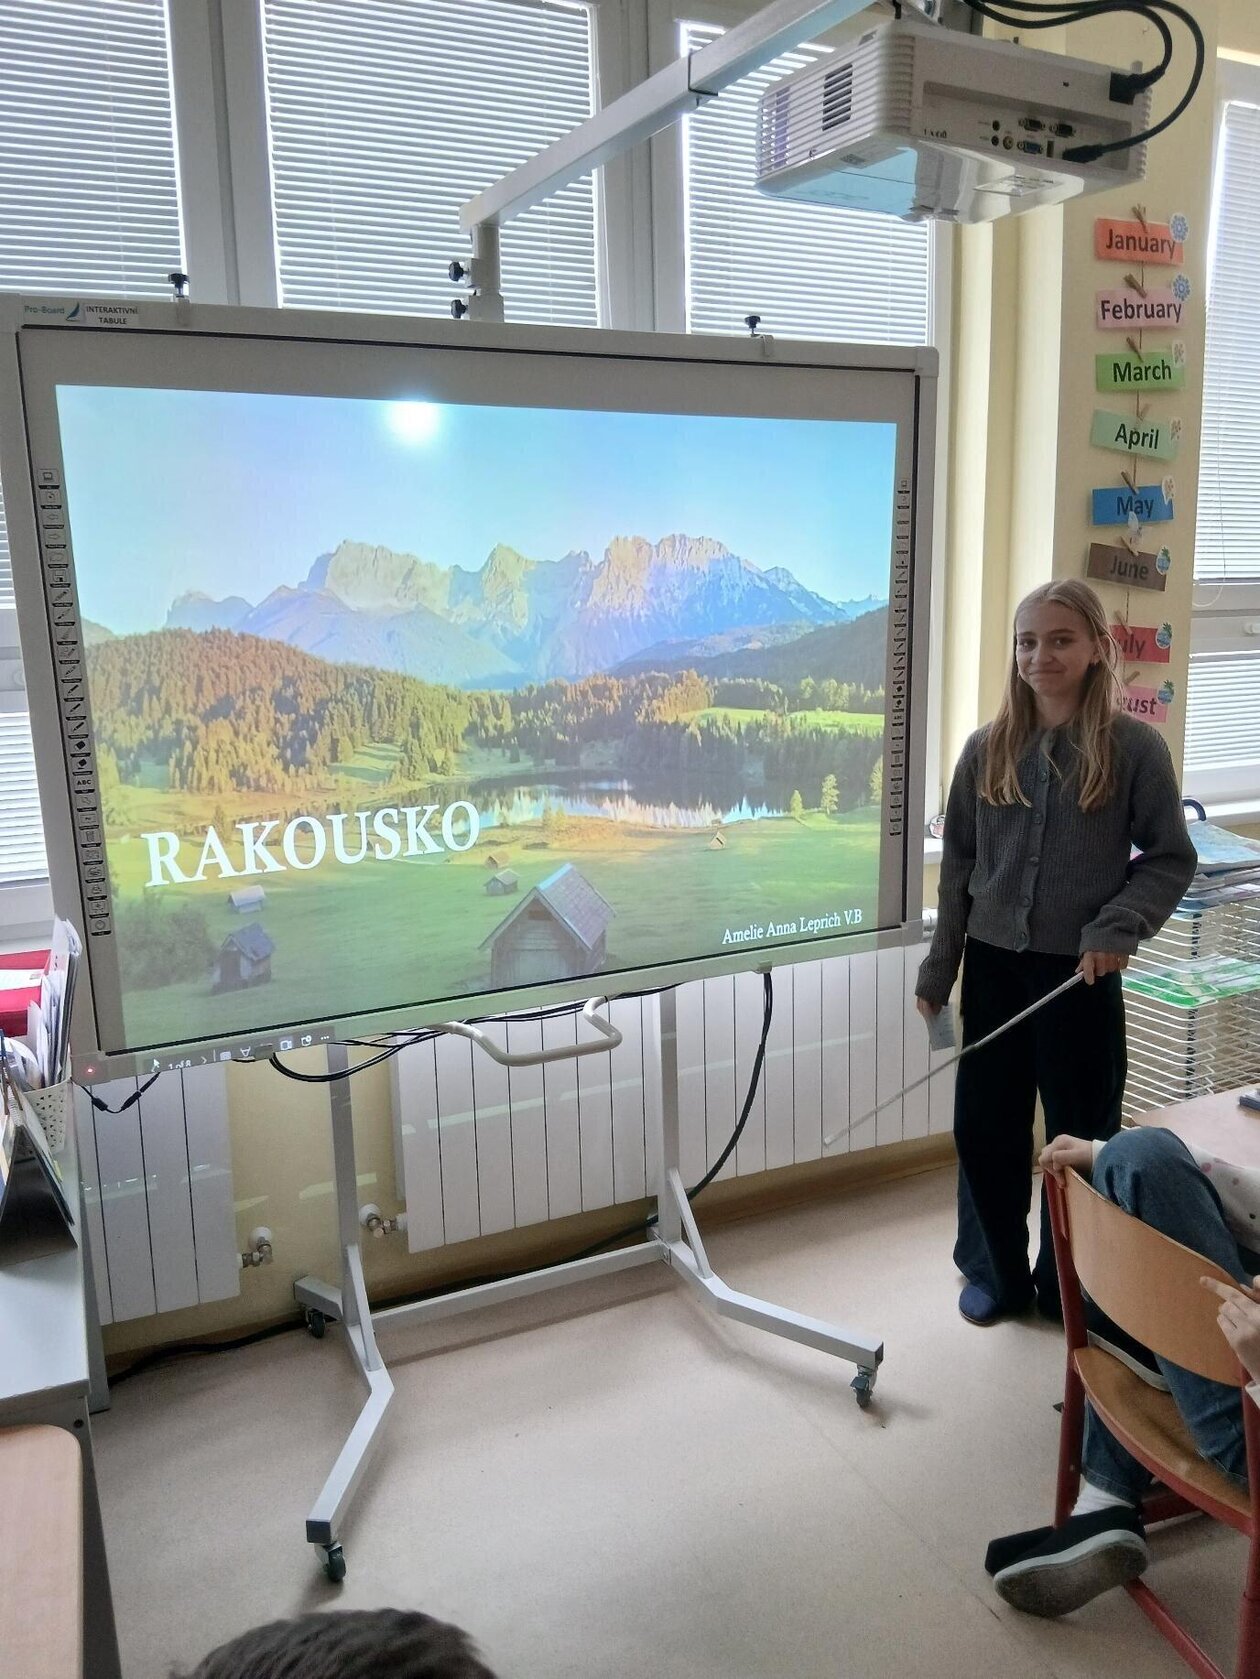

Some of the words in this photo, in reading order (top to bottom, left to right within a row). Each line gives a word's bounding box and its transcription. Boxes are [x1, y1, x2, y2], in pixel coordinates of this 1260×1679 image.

[1105, 229, 1176, 259] January
[99, 317, 127, 325] TABULE
[1100, 299, 1182, 323] February
[1112, 360, 1172, 383] March
[1114, 423, 1159, 450] April
[1116, 496, 1154, 518] May
[1110, 556, 1149, 581] June
[1117, 633, 1146, 659] uly
[140, 800, 481, 887] RAKOUSKO
[722, 923, 764, 944] Amelie
[766, 920, 797, 938] Anna
[799, 911, 841, 934] Leprich
[843, 908, 863, 925] V.B
